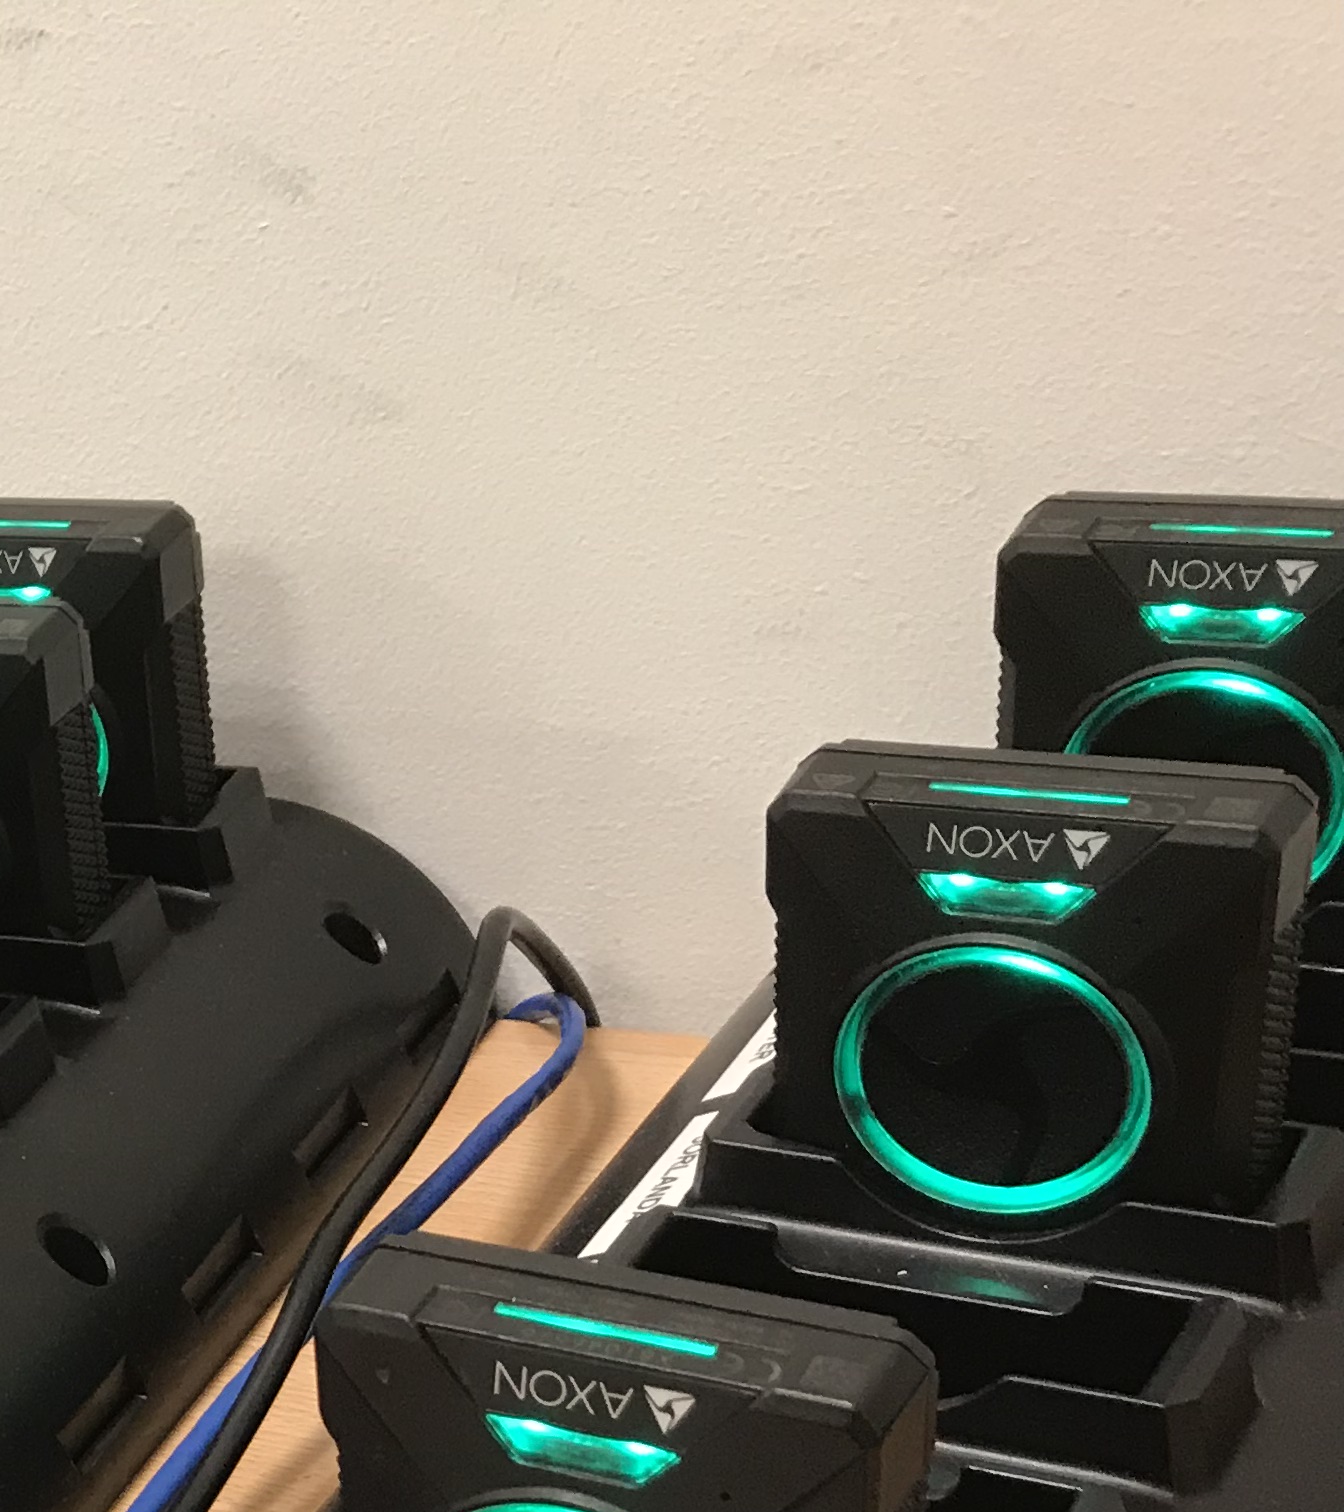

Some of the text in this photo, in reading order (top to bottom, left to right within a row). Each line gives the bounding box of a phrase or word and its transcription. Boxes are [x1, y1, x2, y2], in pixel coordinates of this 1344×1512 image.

[1148, 557, 1267, 592] AXON
[926, 821, 1055, 863] AXON
[493, 1358, 633, 1421] AXON
